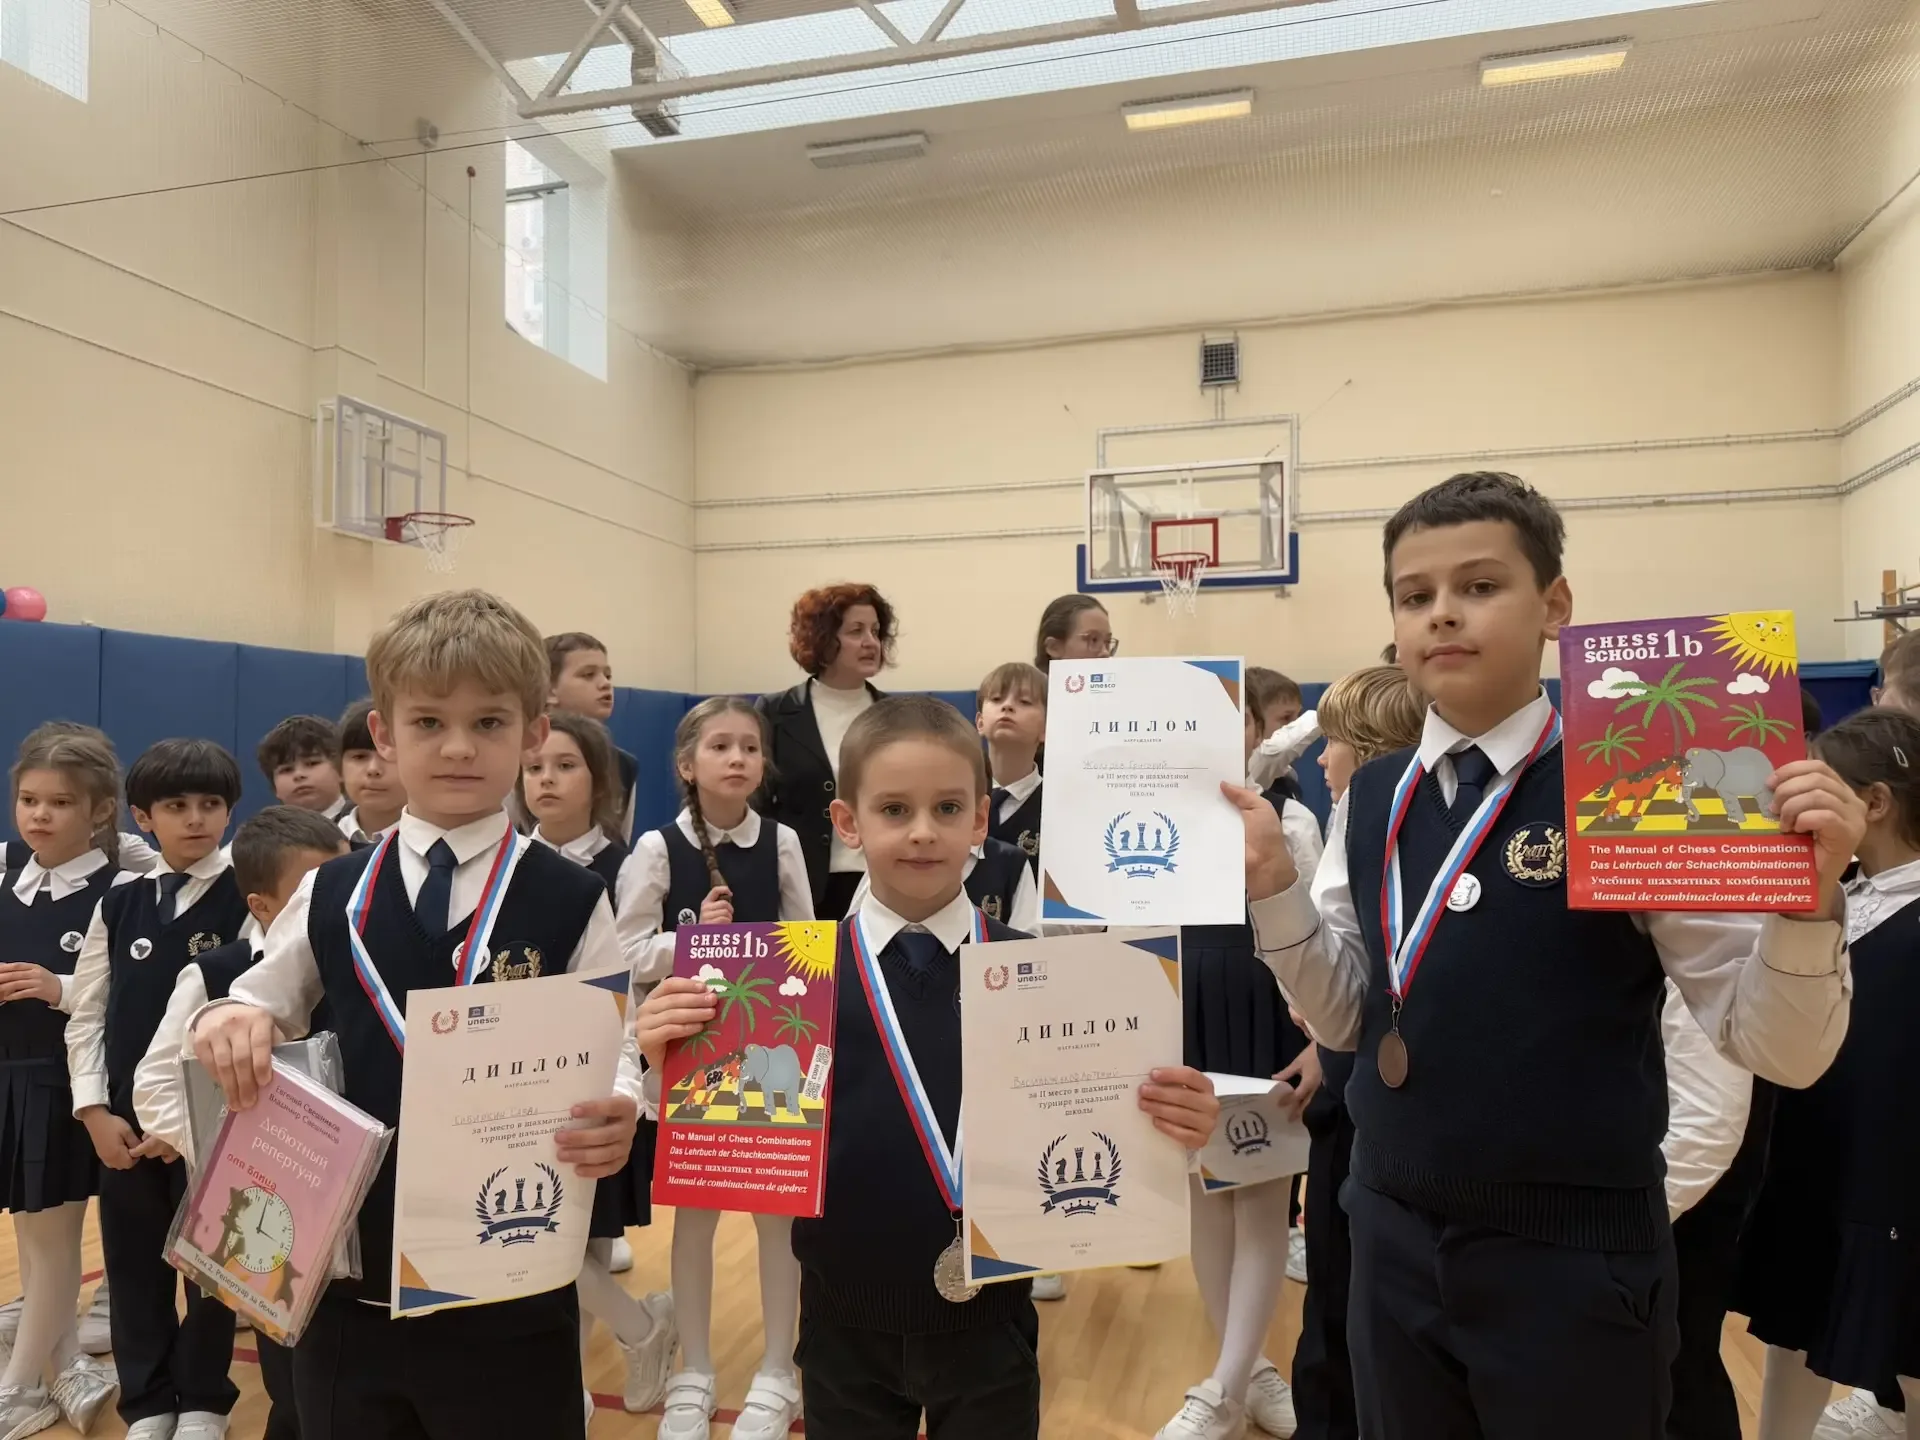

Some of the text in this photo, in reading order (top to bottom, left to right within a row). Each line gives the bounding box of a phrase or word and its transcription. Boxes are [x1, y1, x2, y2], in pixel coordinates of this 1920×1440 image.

[1584, 632, 1659, 650] CHESS
[1584, 629, 1703, 663] SCHOOL 1b
[1089, 720, 1197, 735] ДИПЛОМ
[1589, 844, 1808, 854] The Manual of Chess Combinations
[1590, 860, 1810, 870] Das Lehrbuch der Schachkombinationen
[1591, 876, 1811, 886] Учебник шахматных комбинаций
[1592, 891, 1812, 904] Manual de combinaciones de ajedrez
[689, 931, 769, 959] SCHOOL 1b
[690, 933, 741, 946] CHESS
[1017, 974, 1048, 983] unesco
[467, 1016, 500, 1026] unesco
[1017, 1016, 1139, 1044] ДИПЛОМ
[462, 1051, 590, 1084] ДИПЛОМ
[1039, 1090, 1047, 1098] II
[1048, 1088, 1072, 1097] место
[1081, 1082, 1129, 1093] шахматном
[275, 1085, 341, 1132] Евгений Свешников
[1038, 1093, 1120, 1110] турнире начальной
[269, 1093, 340, 1144] Владимир Свешников
[1065, 1107, 1094, 1116] школы
[472, 1127, 481, 1135] за
[484, 1125, 488, 1133] I
[489, 1122, 515, 1131] место
[524, 1115, 574, 1127] шахматном
[259, 1117, 329, 1170] Дебютный
[480, 1126, 566, 1144] турнире начальной
[671, 1131, 812, 1147] The Manual of Chess Combinations
[508, 1139, 538, 1149] школы
[251, 1136, 322, 1189] репертуар
[670, 1146, 811, 1162] Das Lehrbuch der Schachkombinationen
[668, 1160, 809, 1178] Учебник шахматных комбинаций
[667, 1176, 808, 1194] Manual de combinaciones de ajedrez
[194, 1253, 210, 1269] Том
[215, 1268, 250, 1299] Репертуар
[249, 1294, 258, 1303] за
